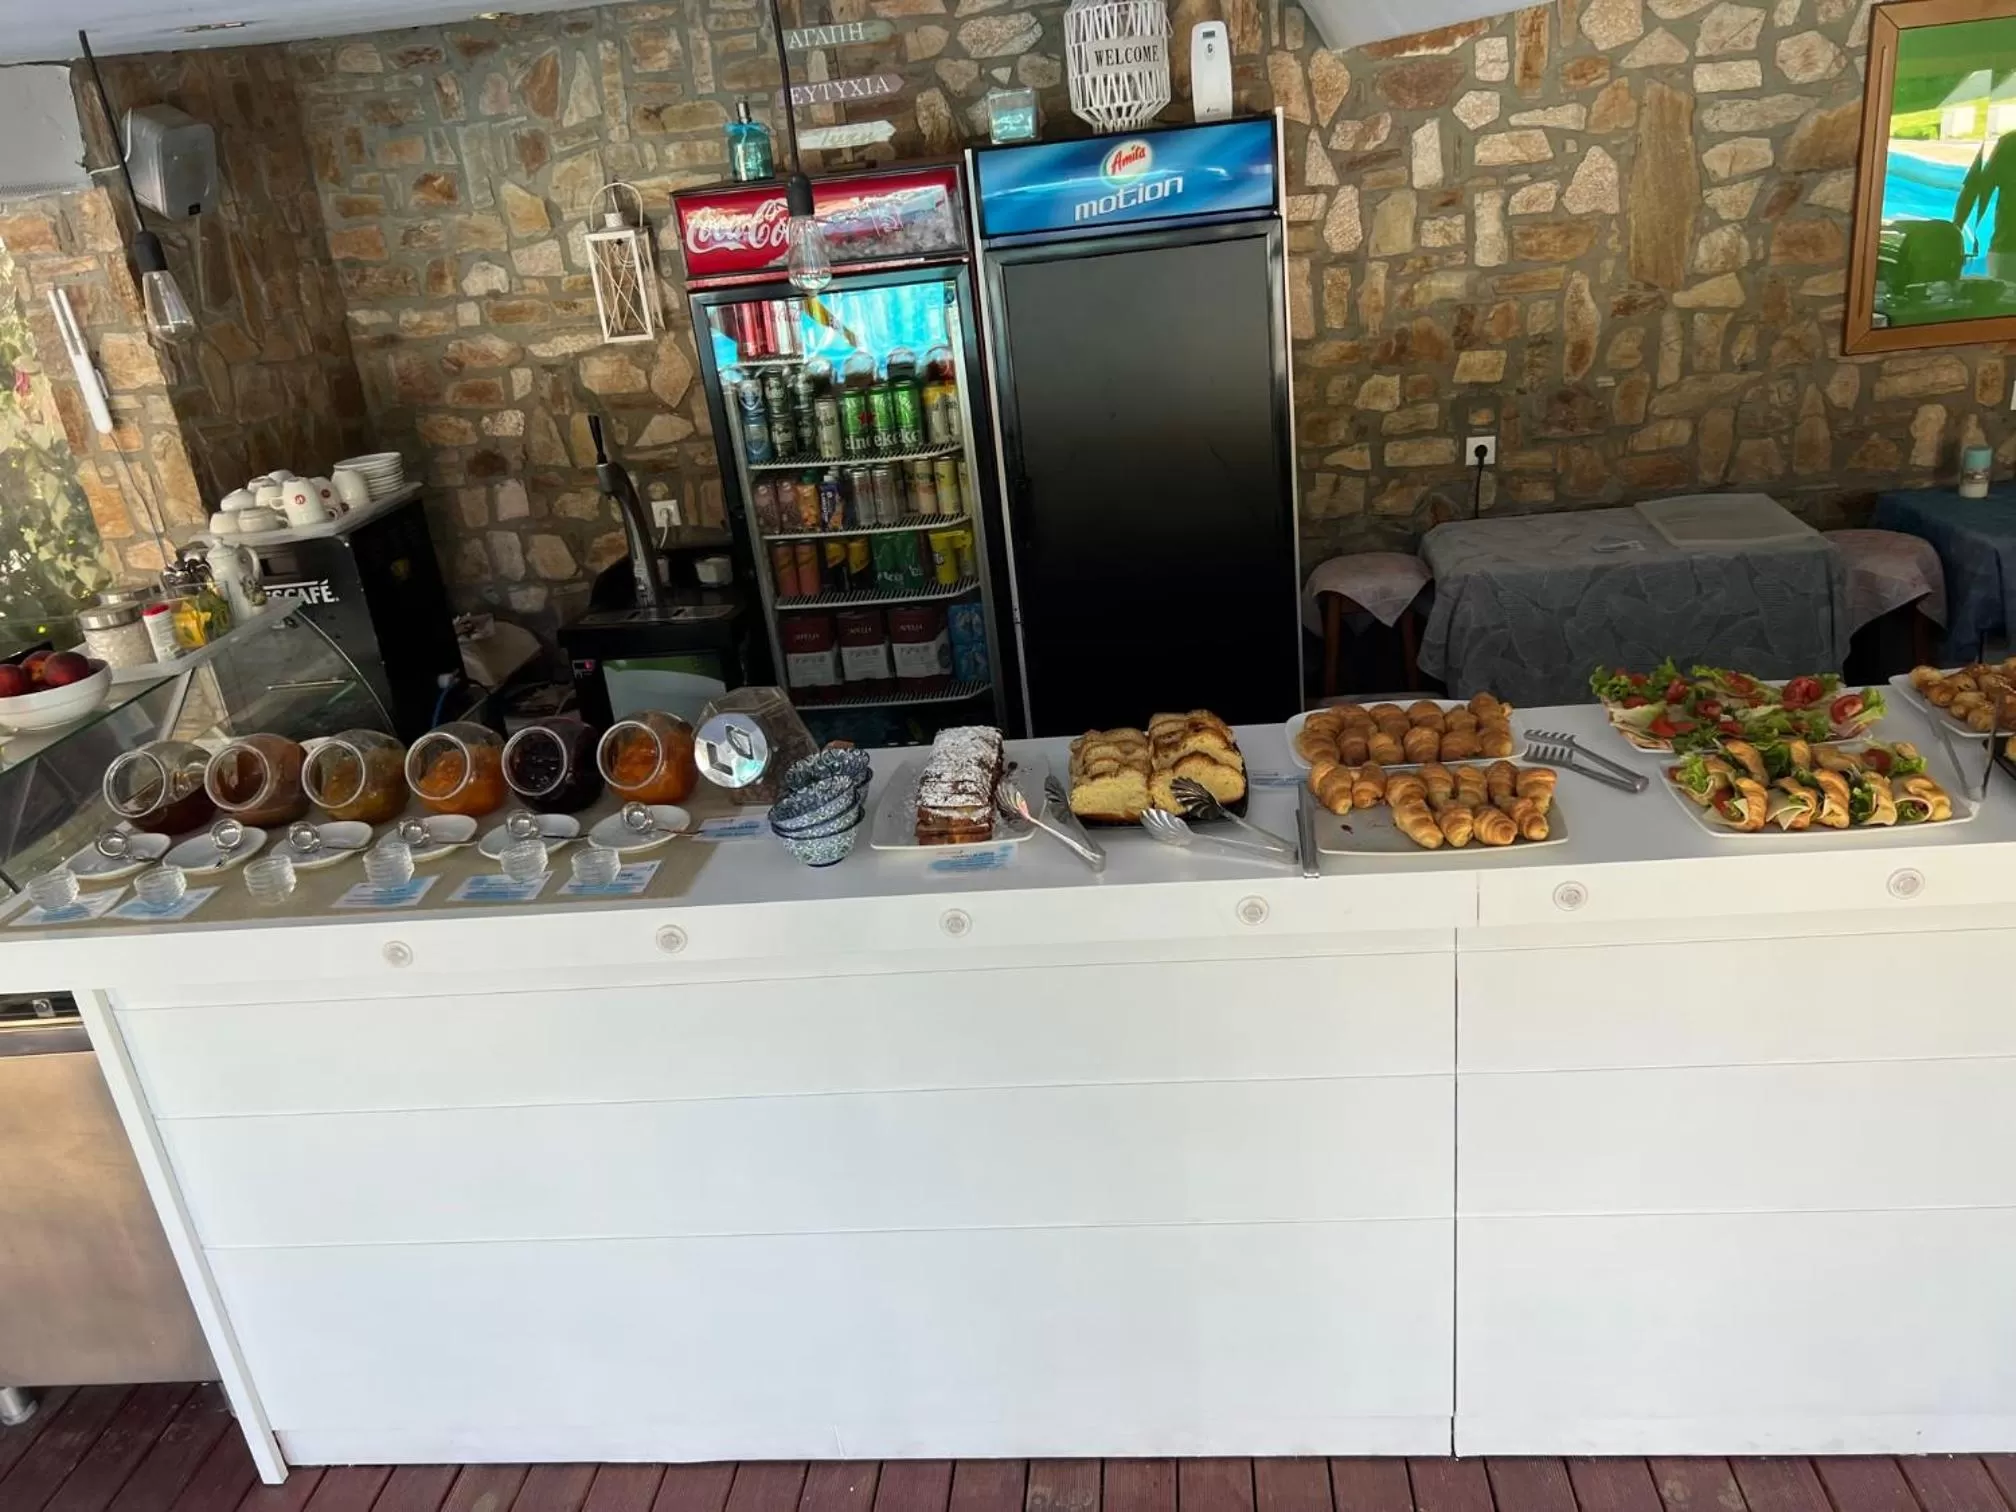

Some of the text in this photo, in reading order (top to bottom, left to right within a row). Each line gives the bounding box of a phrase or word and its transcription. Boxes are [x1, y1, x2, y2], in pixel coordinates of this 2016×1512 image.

[788, 22, 864, 48] ΑΓΑΠΗ
[1094, 44, 1160, 67] WELCOME
[790, 76, 890, 105] ΕΥΤΥΧΙΑ
[1111, 144, 1147, 175] Amita
[1075, 176, 1184, 221] motion
